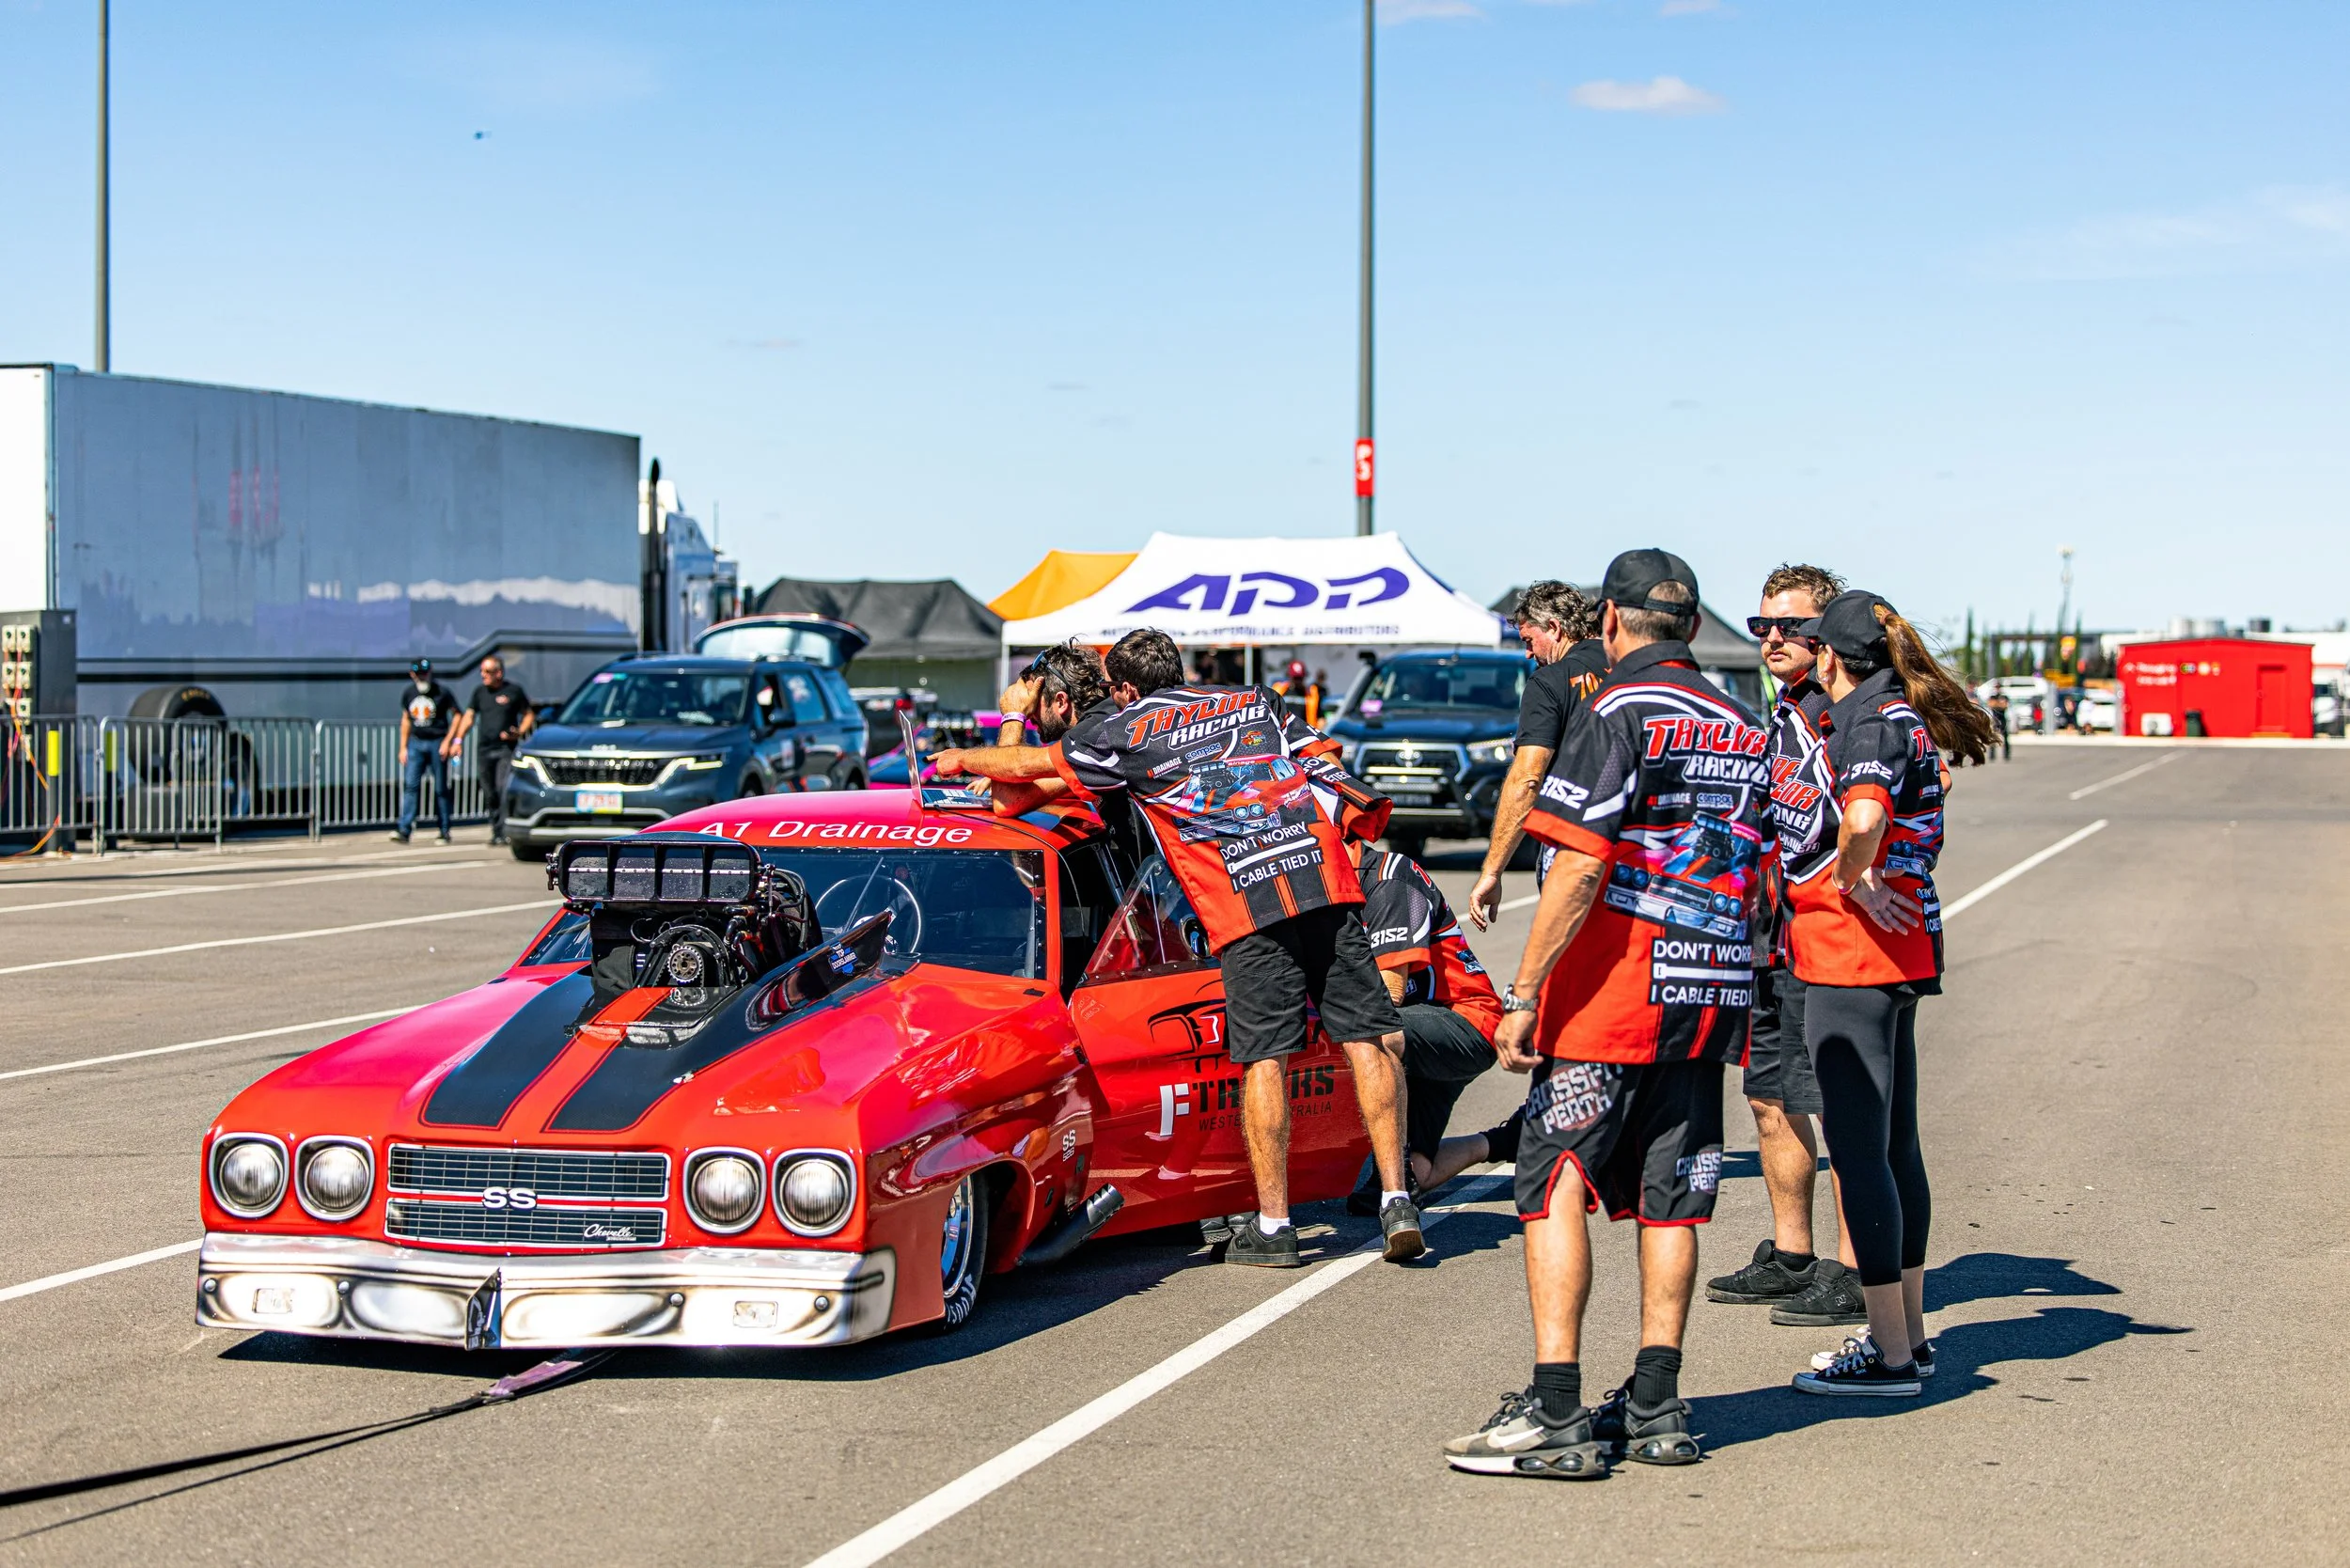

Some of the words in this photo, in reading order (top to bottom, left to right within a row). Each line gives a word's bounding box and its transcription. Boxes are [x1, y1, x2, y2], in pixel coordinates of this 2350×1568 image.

[1170, 704, 1266, 747] RACING
[698, 821, 752, 838] A1
[768, 821, 973, 846] Drainage
[1220, 836, 1260, 861] DON'T
[1258, 821, 1308, 844] WORRY
[1239, 862, 1278, 887] CABLE
[1278, 854, 1309, 872] TIED
[1310, 850, 1323, 864] IT
[1371, 926, 1409, 949] 3152
[1653, 940, 1713, 962] DON'T
[1661, 984, 1716, 1005] CABLE
[1718, 987, 1748, 1007] TIED
[1542, 1087, 1613, 1135] PERTH
[482, 1186, 538, 1210] SS
[583, 1222, 634, 1238] Chevelle
